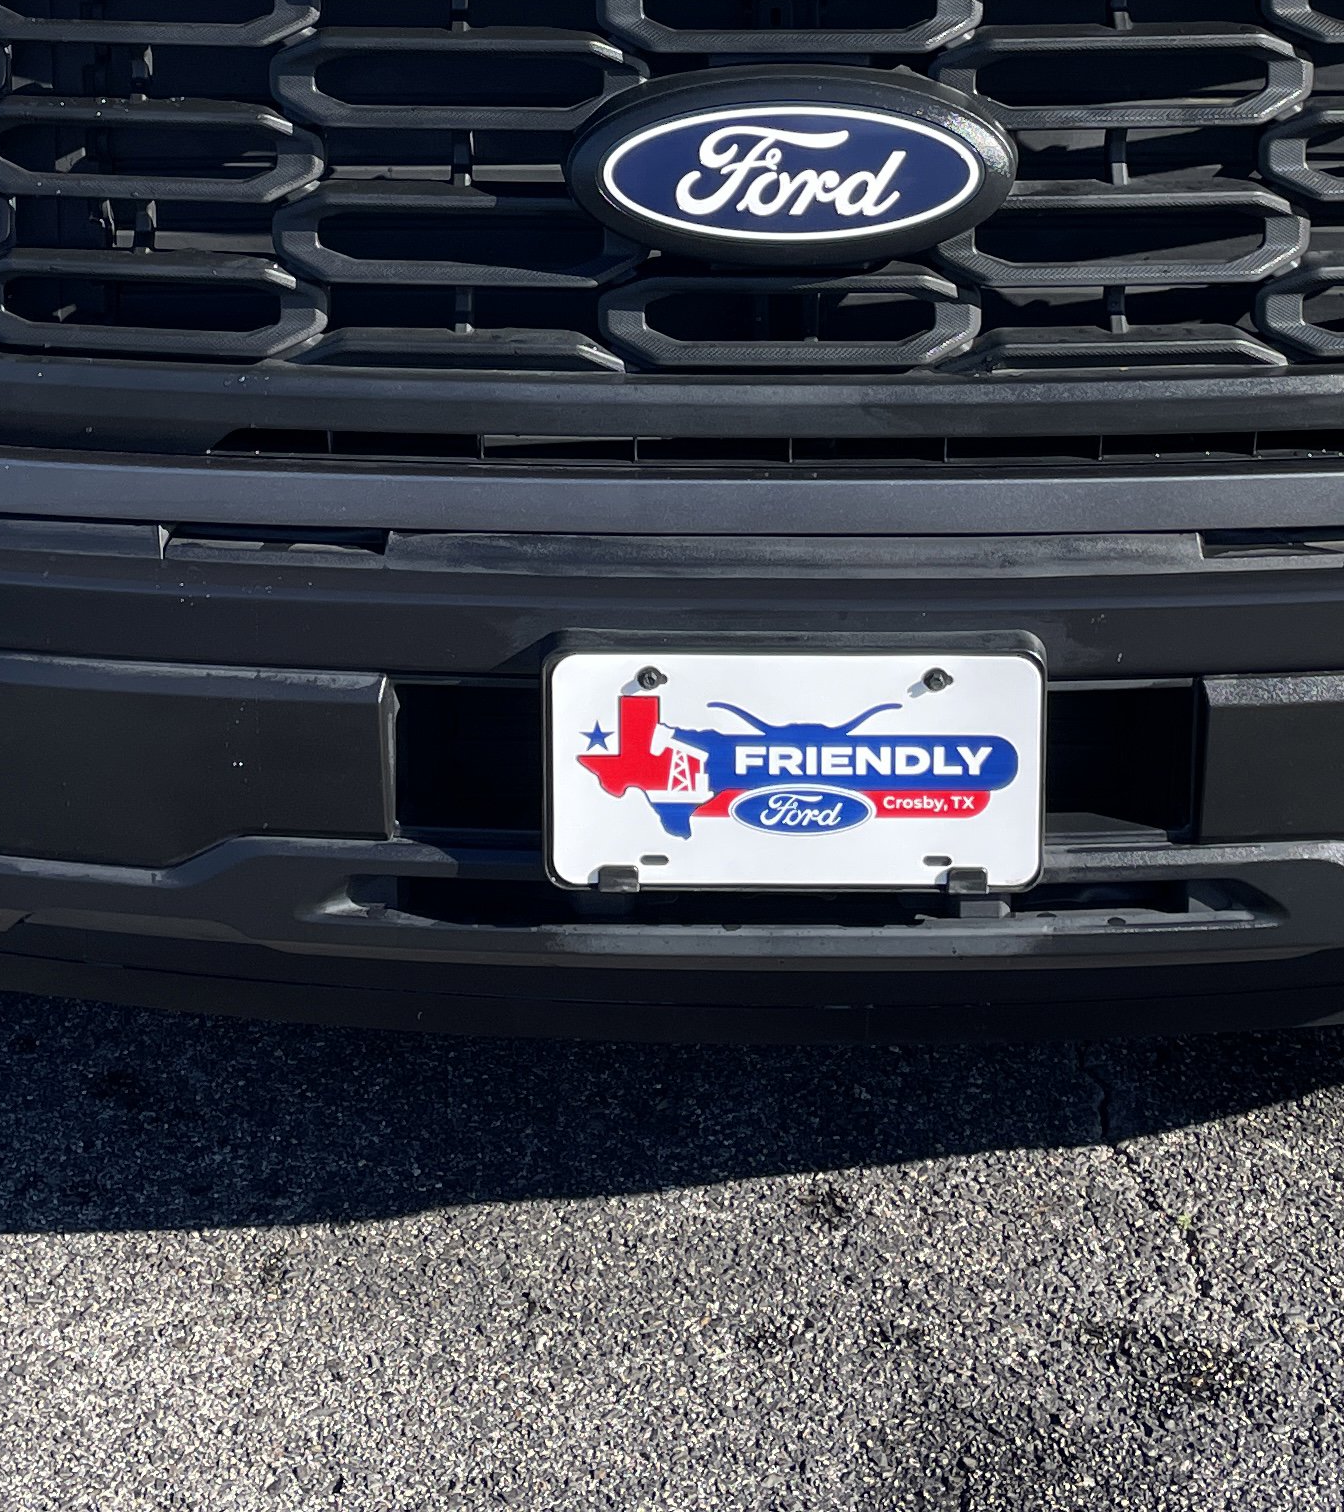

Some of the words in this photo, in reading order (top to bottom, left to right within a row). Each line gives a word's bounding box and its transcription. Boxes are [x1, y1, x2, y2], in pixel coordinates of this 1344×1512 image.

[675, 125, 907, 217] Ford
[734, 745, 993, 776] FRIENDLY
[759, 793, 843, 826] Ford
[883, 795, 948, 812] Crosby,
[951, 796, 975, 809] TX
